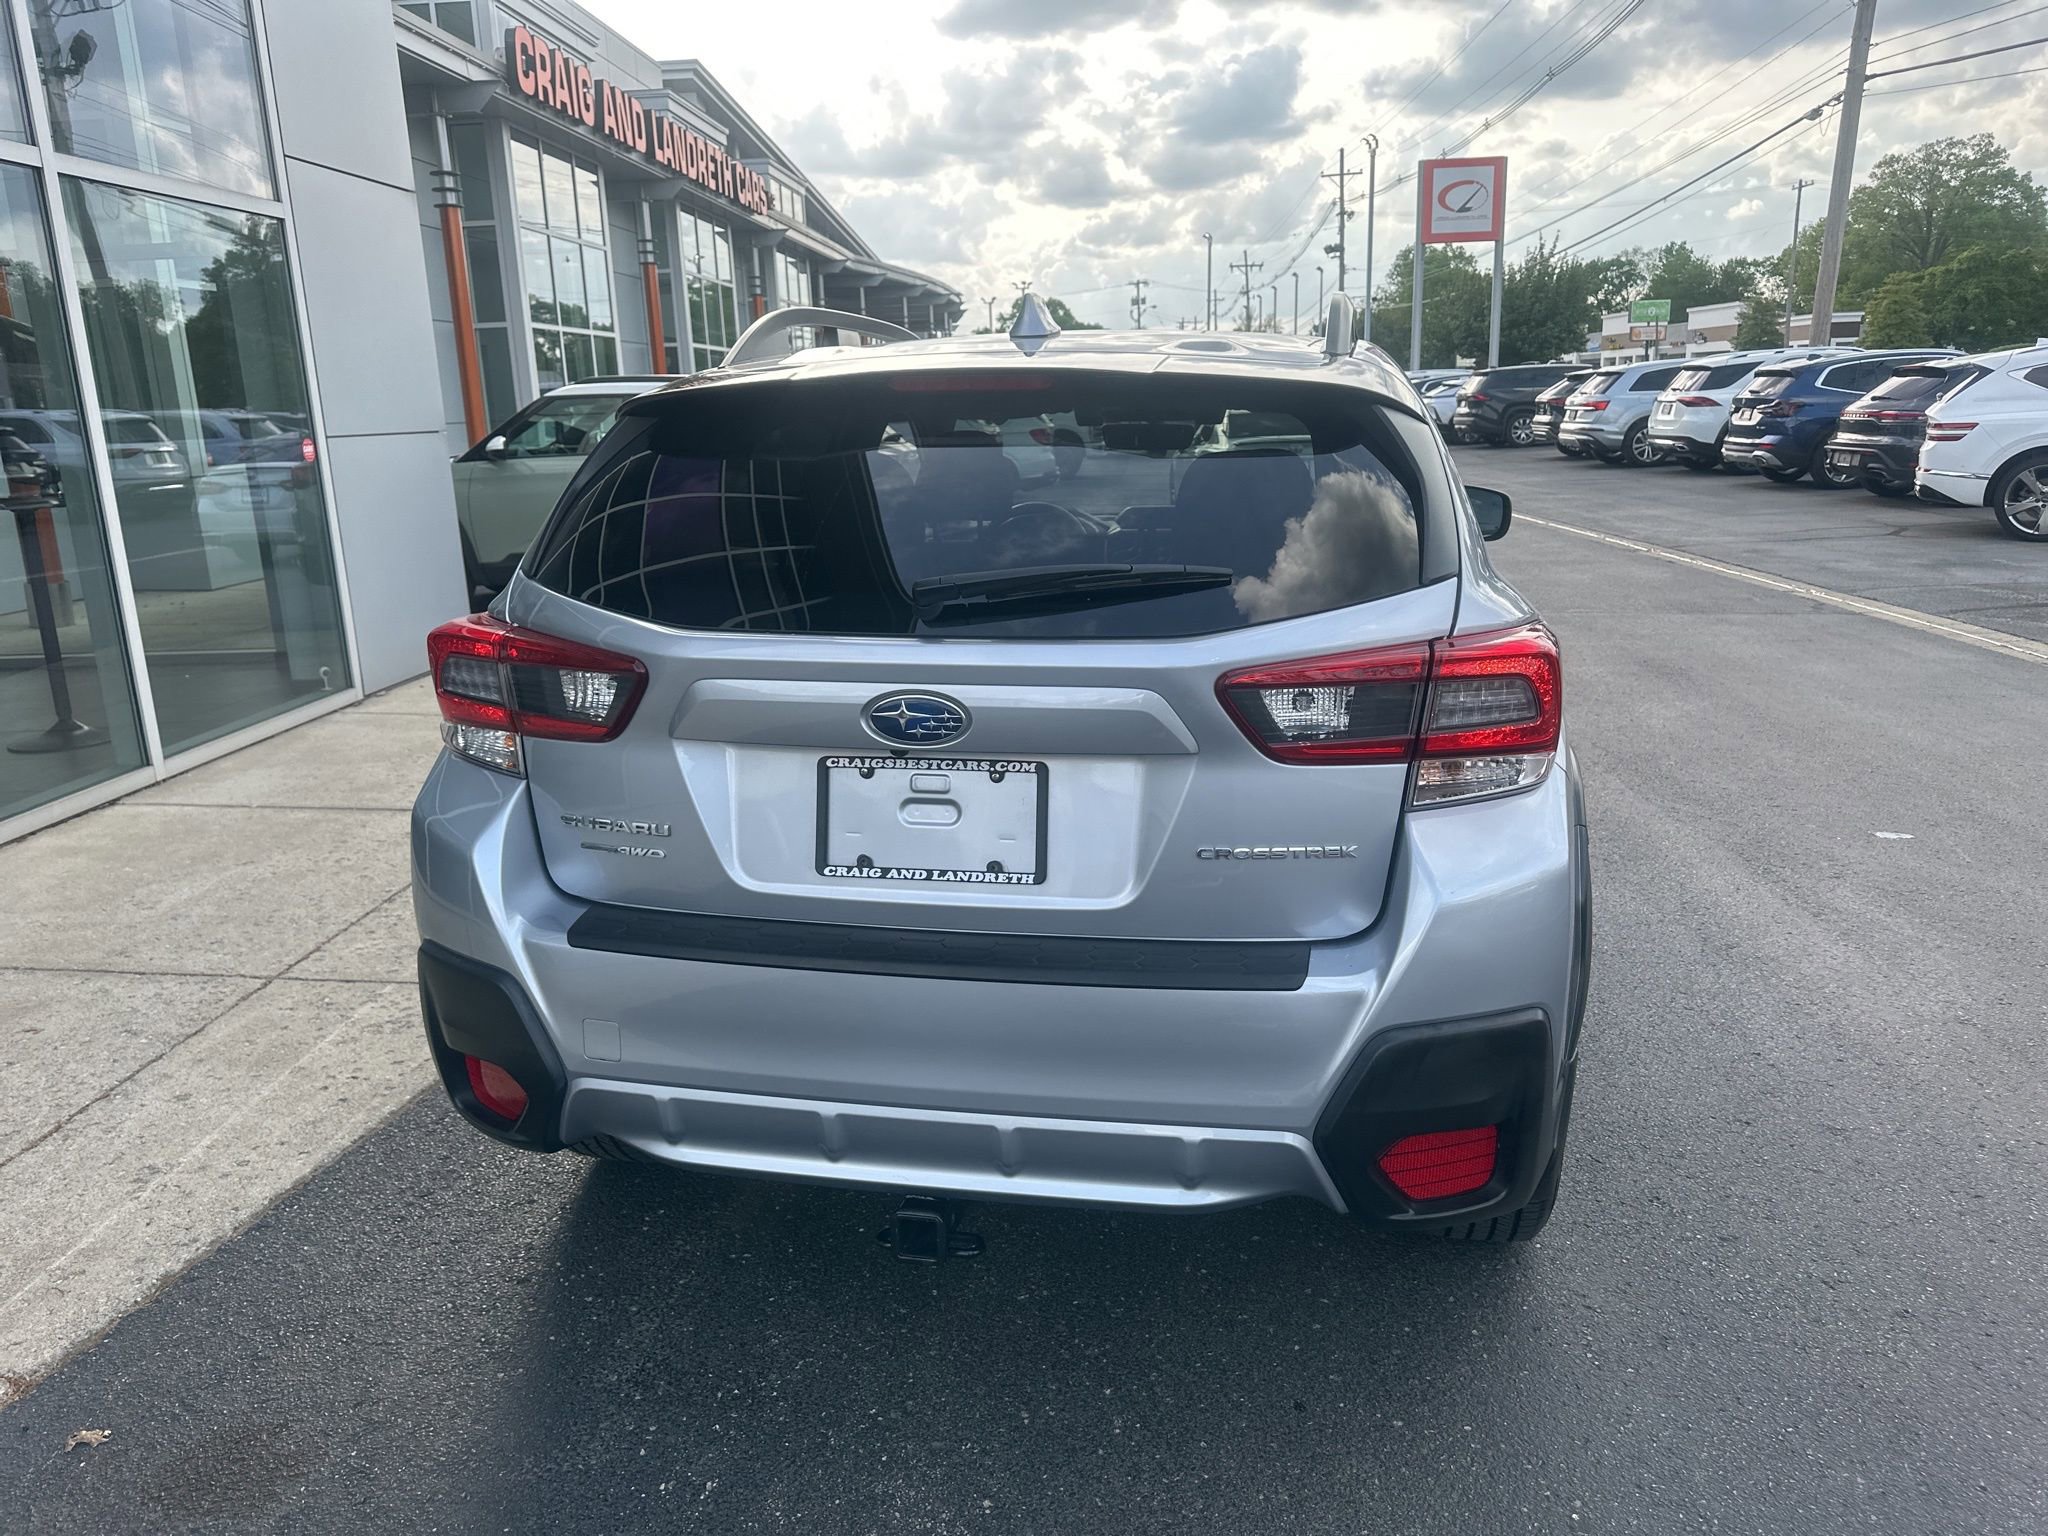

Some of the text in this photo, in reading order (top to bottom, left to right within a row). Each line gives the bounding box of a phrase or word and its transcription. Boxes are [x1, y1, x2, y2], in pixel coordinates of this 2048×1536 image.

[508, 26, 769, 216] CRAIG AND LANDRETH CARS
[825, 757, 1037, 773] CRAIGSBESTCARS.COM
[560, 813, 671, 837] SUBARU
[1196, 845, 1359, 860] CROSSTREK
[823, 866, 1035, 884] CRAIG AND LANDRETH
